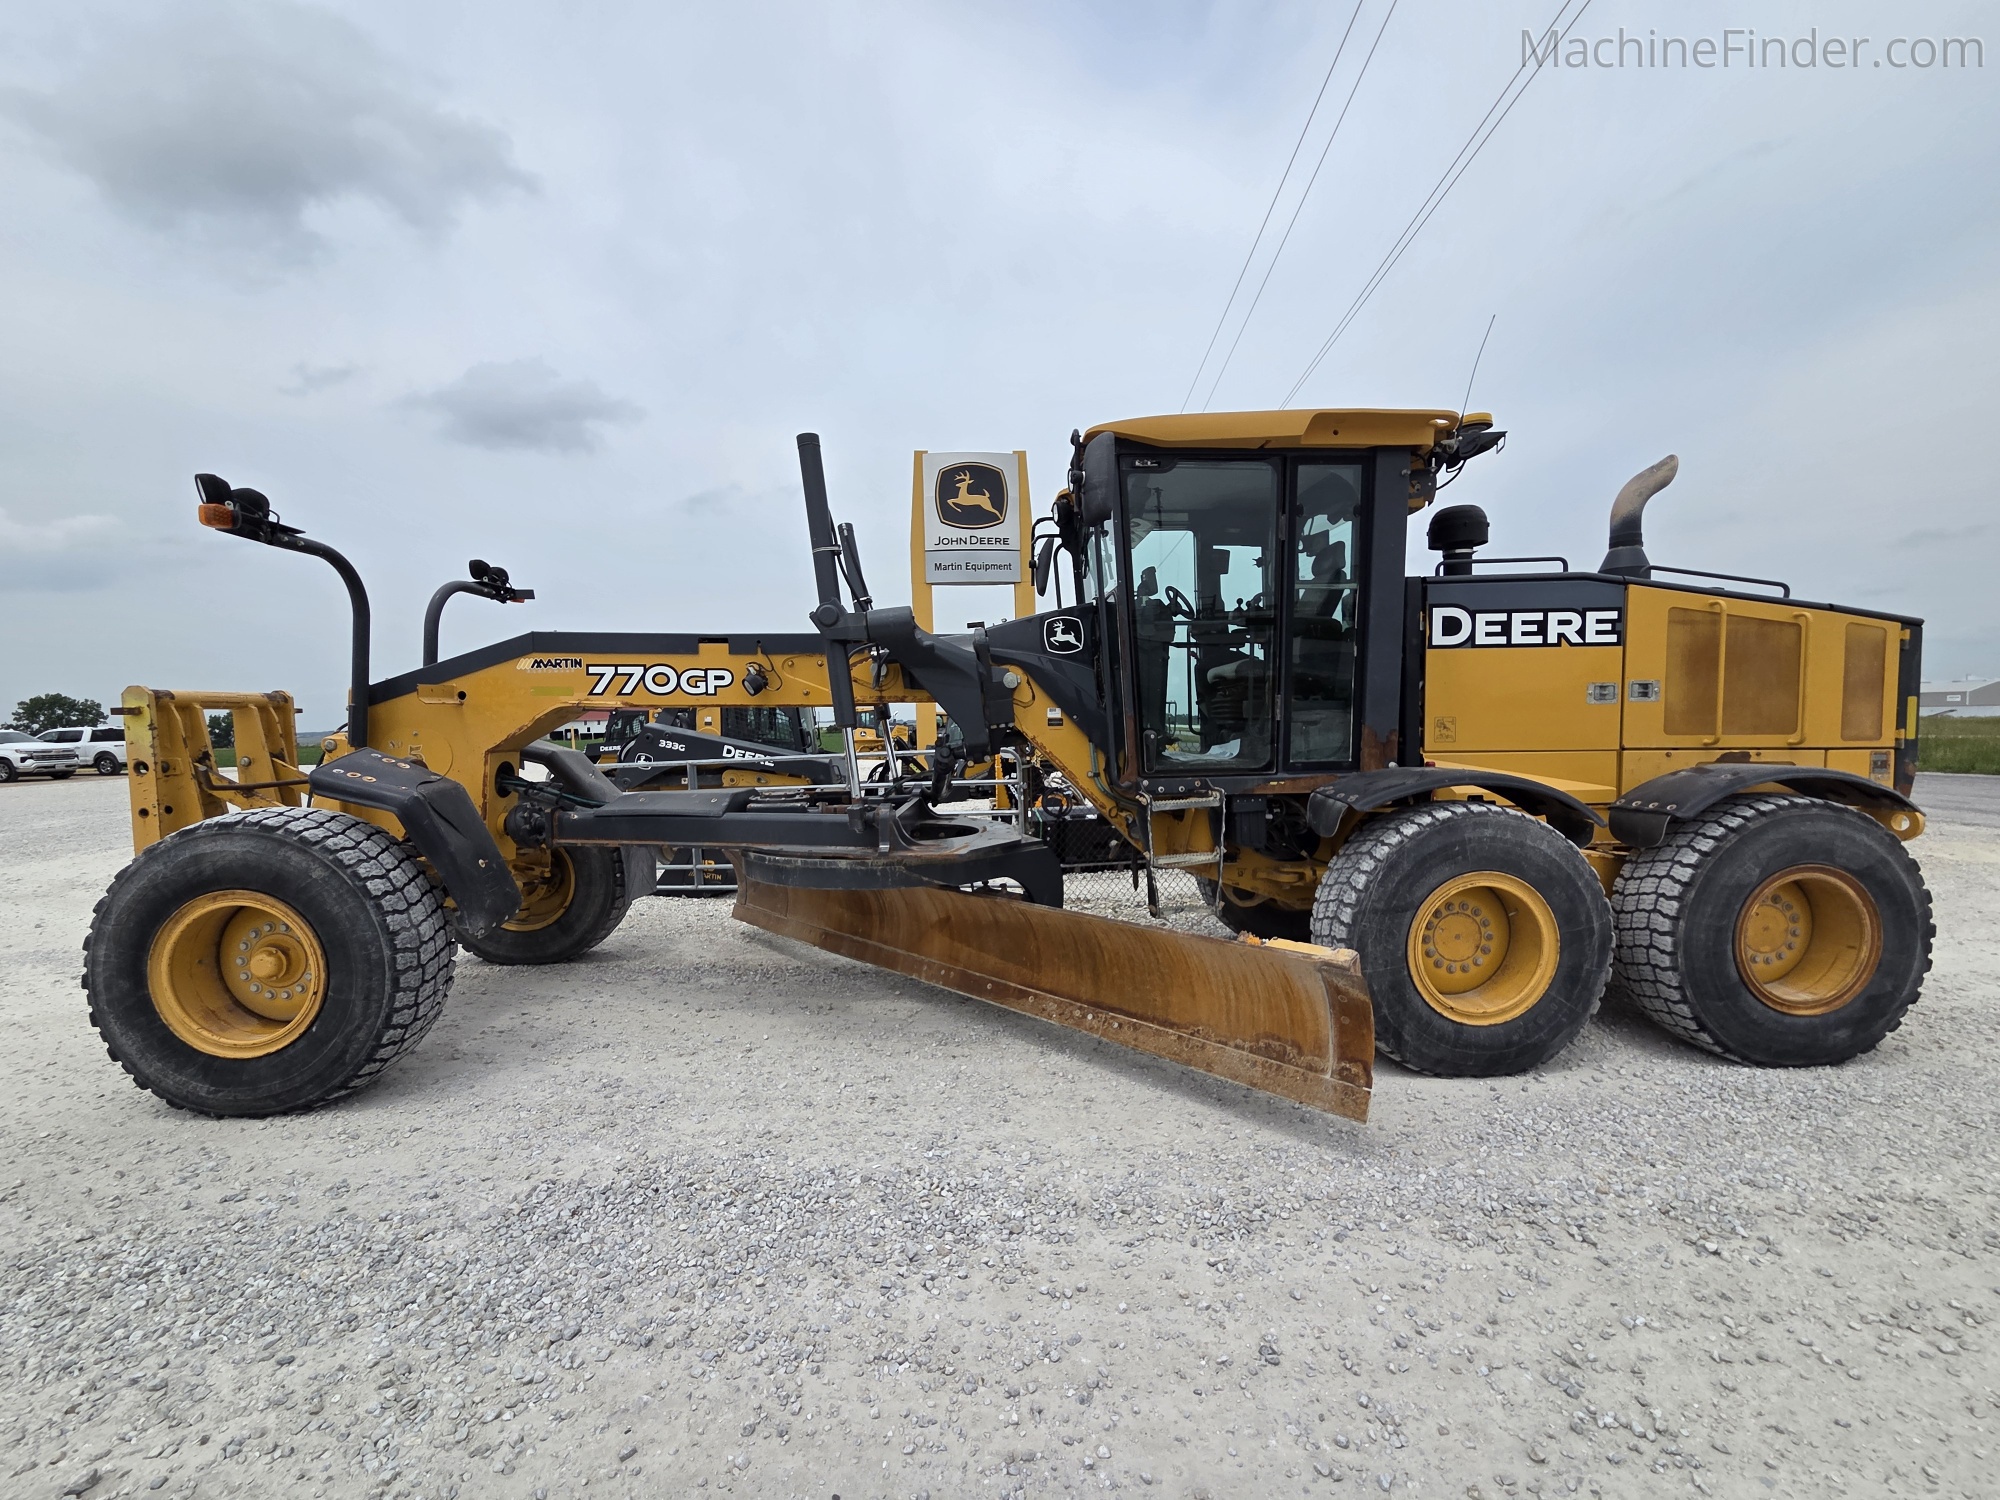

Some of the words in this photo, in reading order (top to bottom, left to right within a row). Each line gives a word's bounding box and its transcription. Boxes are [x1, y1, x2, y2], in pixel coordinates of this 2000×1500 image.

[934, 535, 967, 546] JOHN
[969, 535, 1010, 546] DEERE
[934, 562, 962, 571] Martin
[965, 561, 1013, 572] Equipment
[1431, 606, 1619, 646] DEERE
[531, 658, 582, 668] MARTIN
[586, 663, 733, 696] 770GP
[658, 739, 686, 752] 333G
